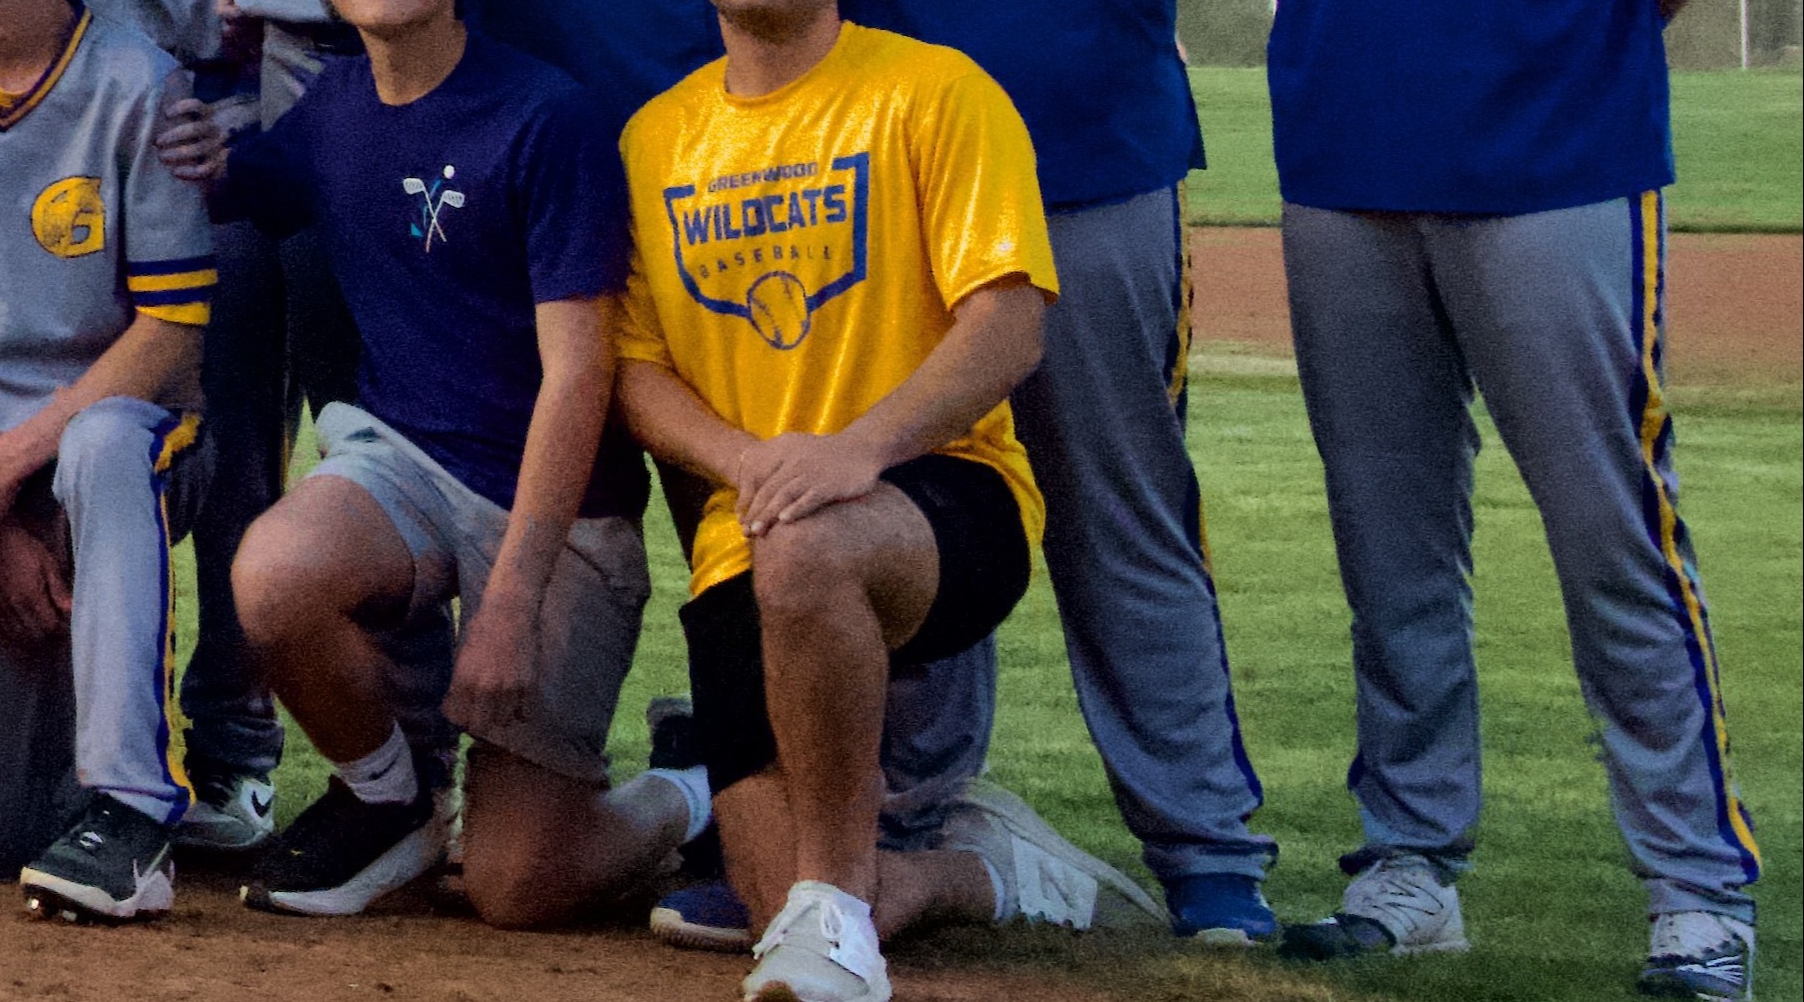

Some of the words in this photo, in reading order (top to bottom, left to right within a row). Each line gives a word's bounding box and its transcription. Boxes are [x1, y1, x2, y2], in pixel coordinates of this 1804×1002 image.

[707, 162, 818, 192] GREENWOOD
[683, 184, 848, 246] WILDCATS
[698, 245, 831, 279] BASEBALL
